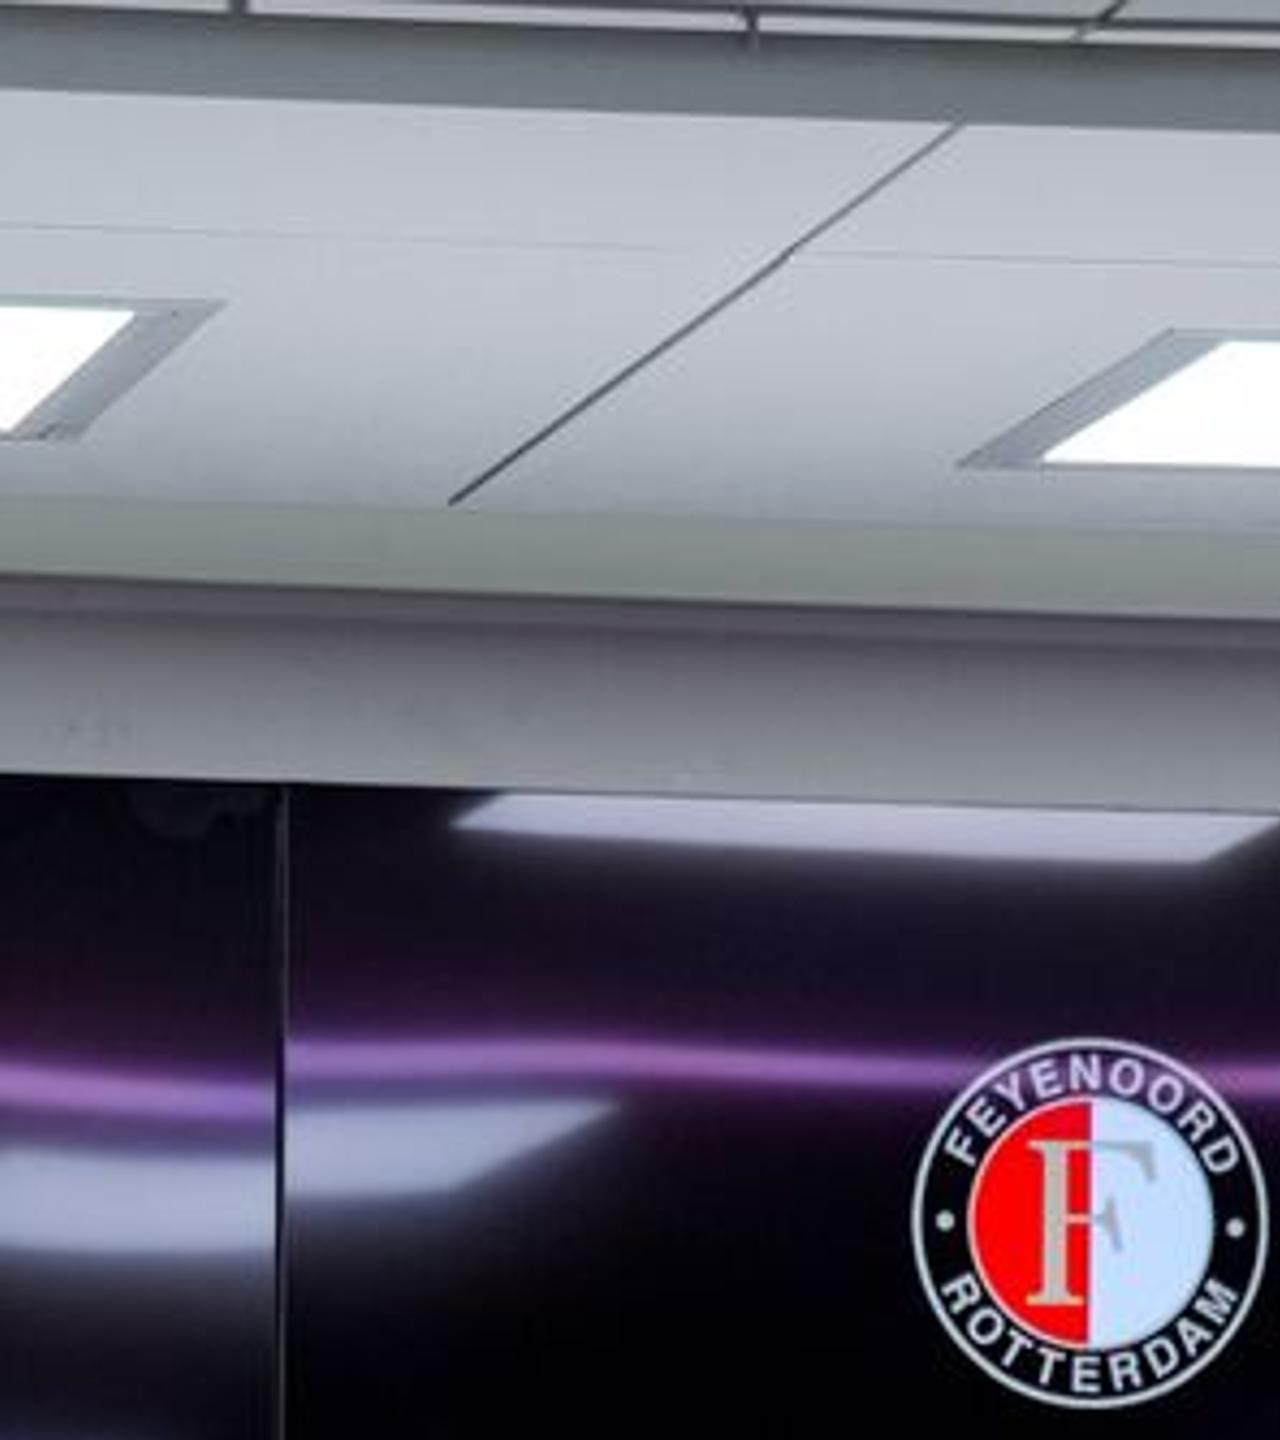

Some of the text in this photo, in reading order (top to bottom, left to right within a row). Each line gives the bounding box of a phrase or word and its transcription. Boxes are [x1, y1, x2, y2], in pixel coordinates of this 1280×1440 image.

[946, 1054, 1240, 1176] FEYENOORD
[1026, 1139, 1157, 1305] F
[940, 1271, 1239, 1393] ROTTERDAM
